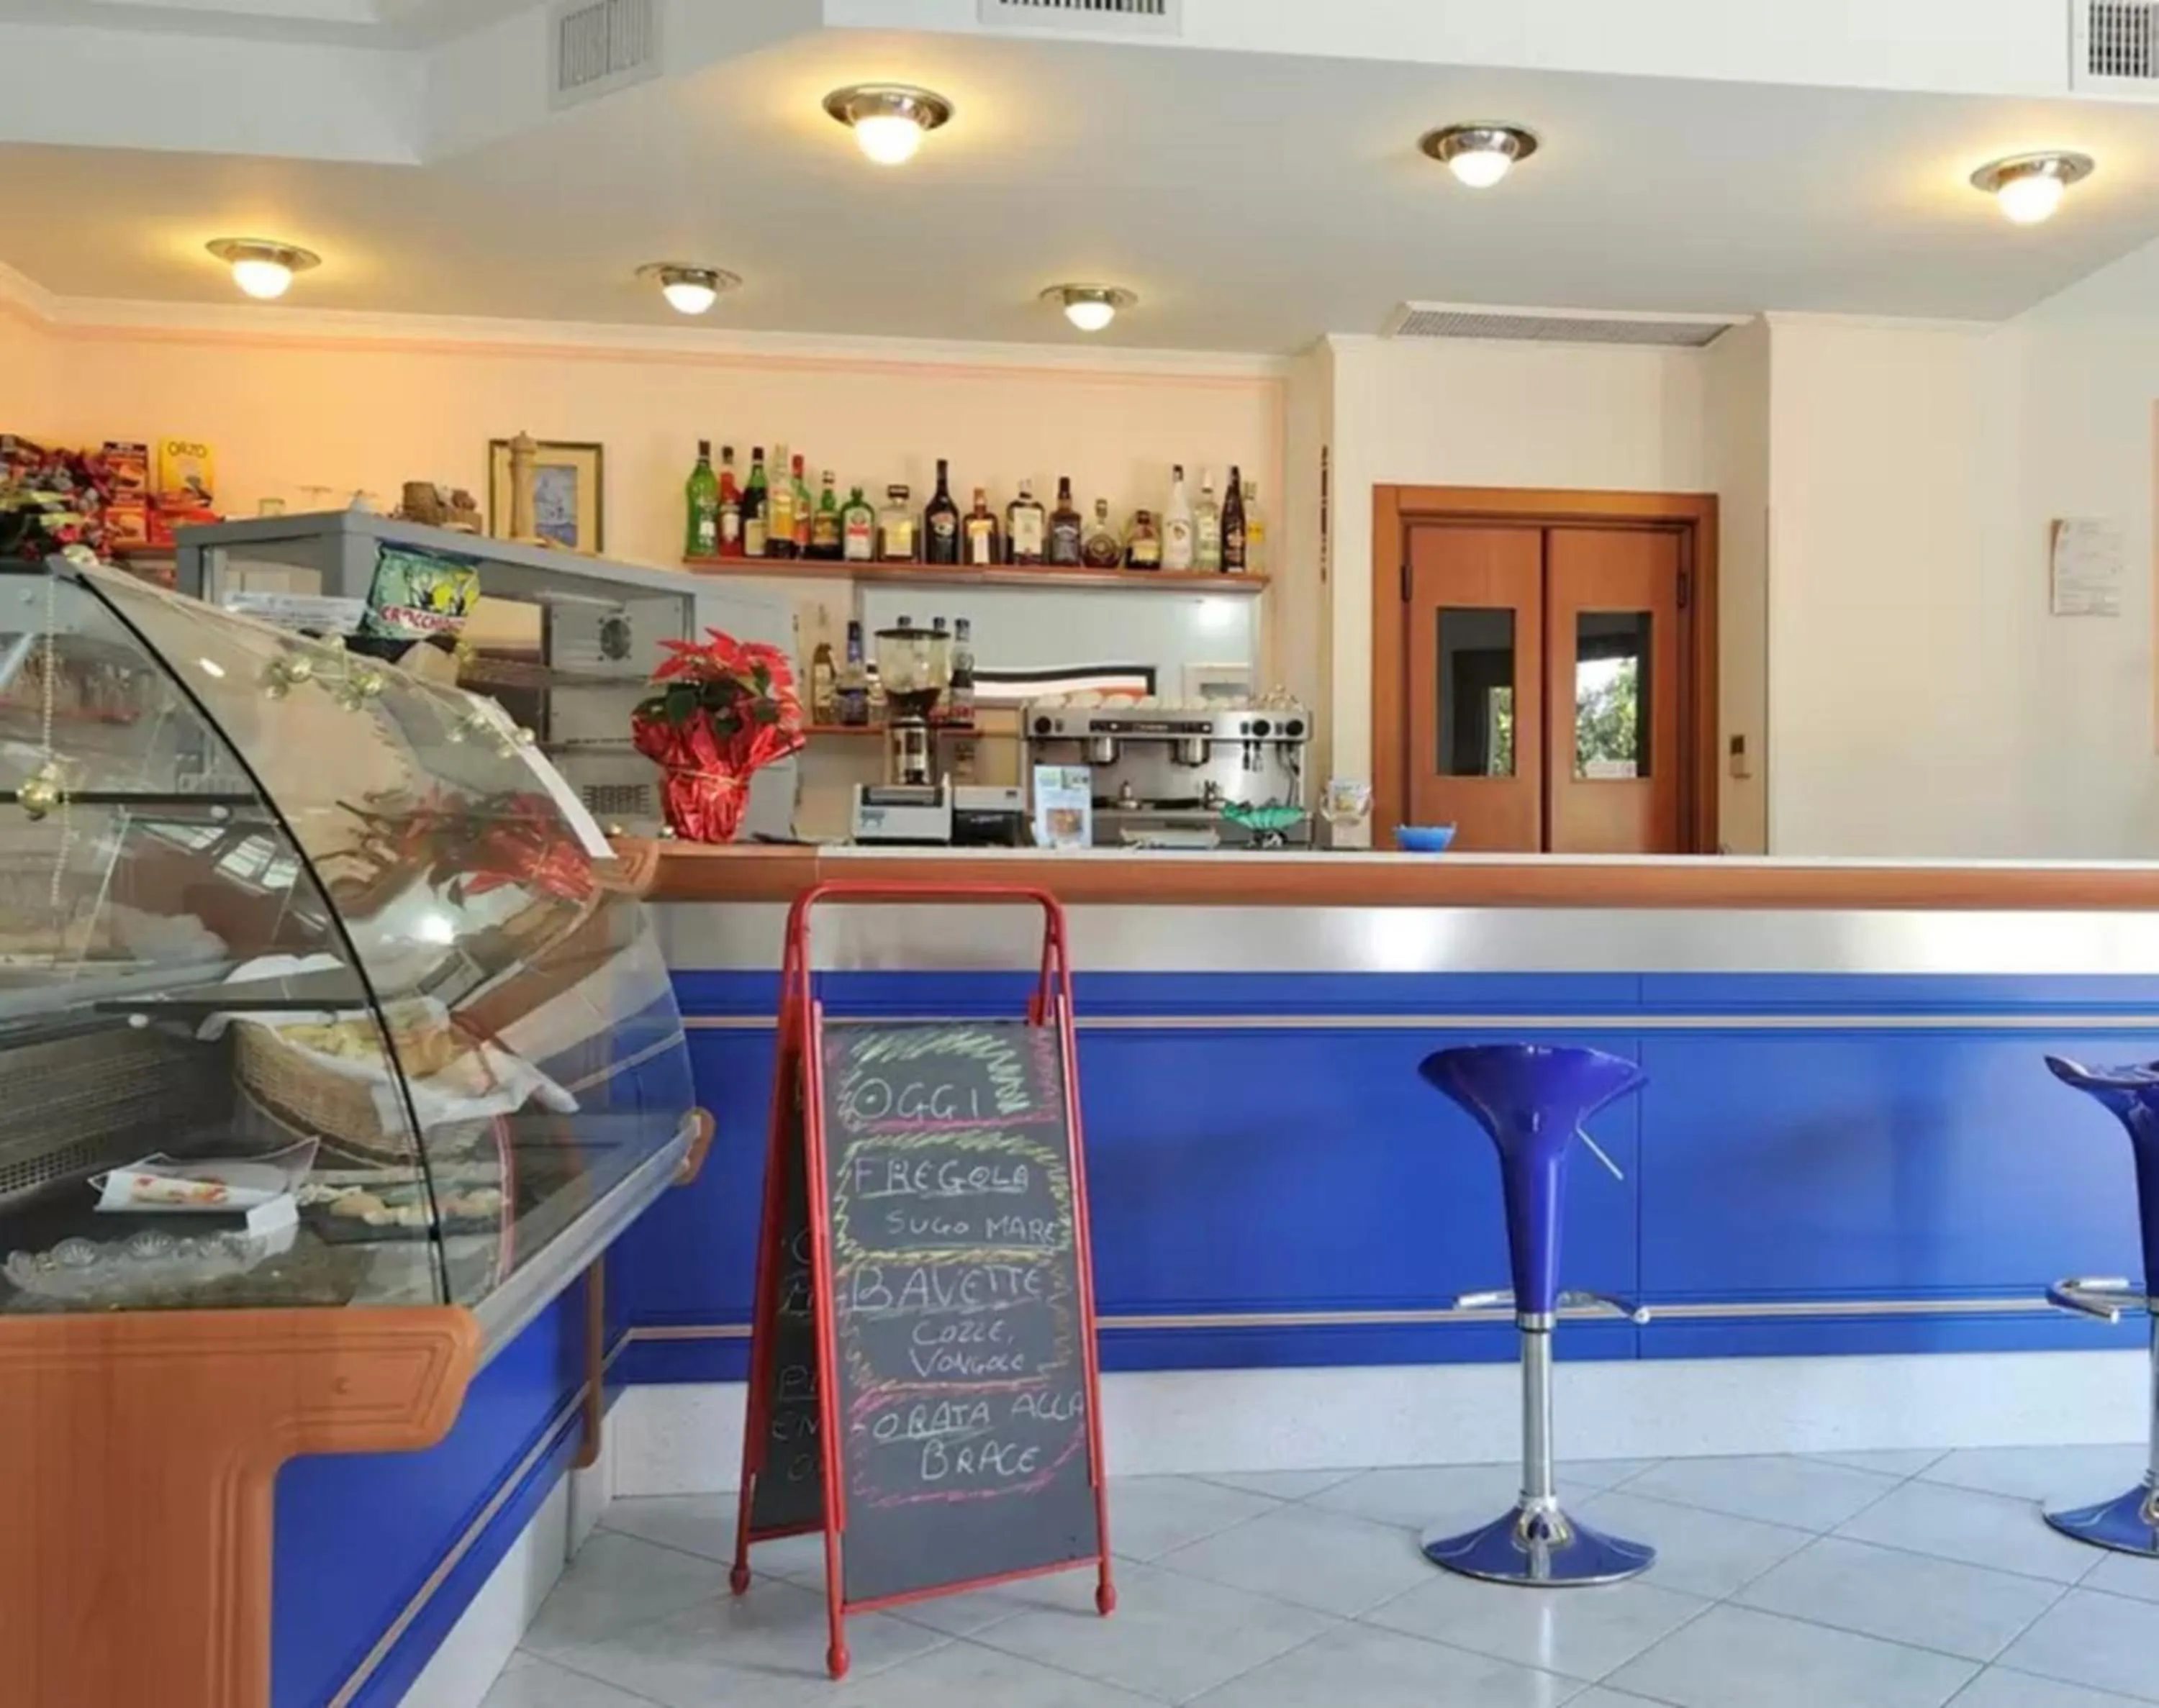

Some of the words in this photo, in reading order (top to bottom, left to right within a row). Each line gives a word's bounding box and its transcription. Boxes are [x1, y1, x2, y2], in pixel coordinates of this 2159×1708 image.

[168, 441, 207, 458] ORZO
[854, 1077, 979, 1120] OGGI
[854, 1156, 1029, 1192] FREGOLA
[985, 1214, 1056, 1245] MARE
[851, 1263, 1042, 1311] BAVETTE
[872, 1402, 991, 1439] ORATA
[1010, 1389, 1085, 1422] ALLA
[920, 1439, 1041, 1481] BRACE
